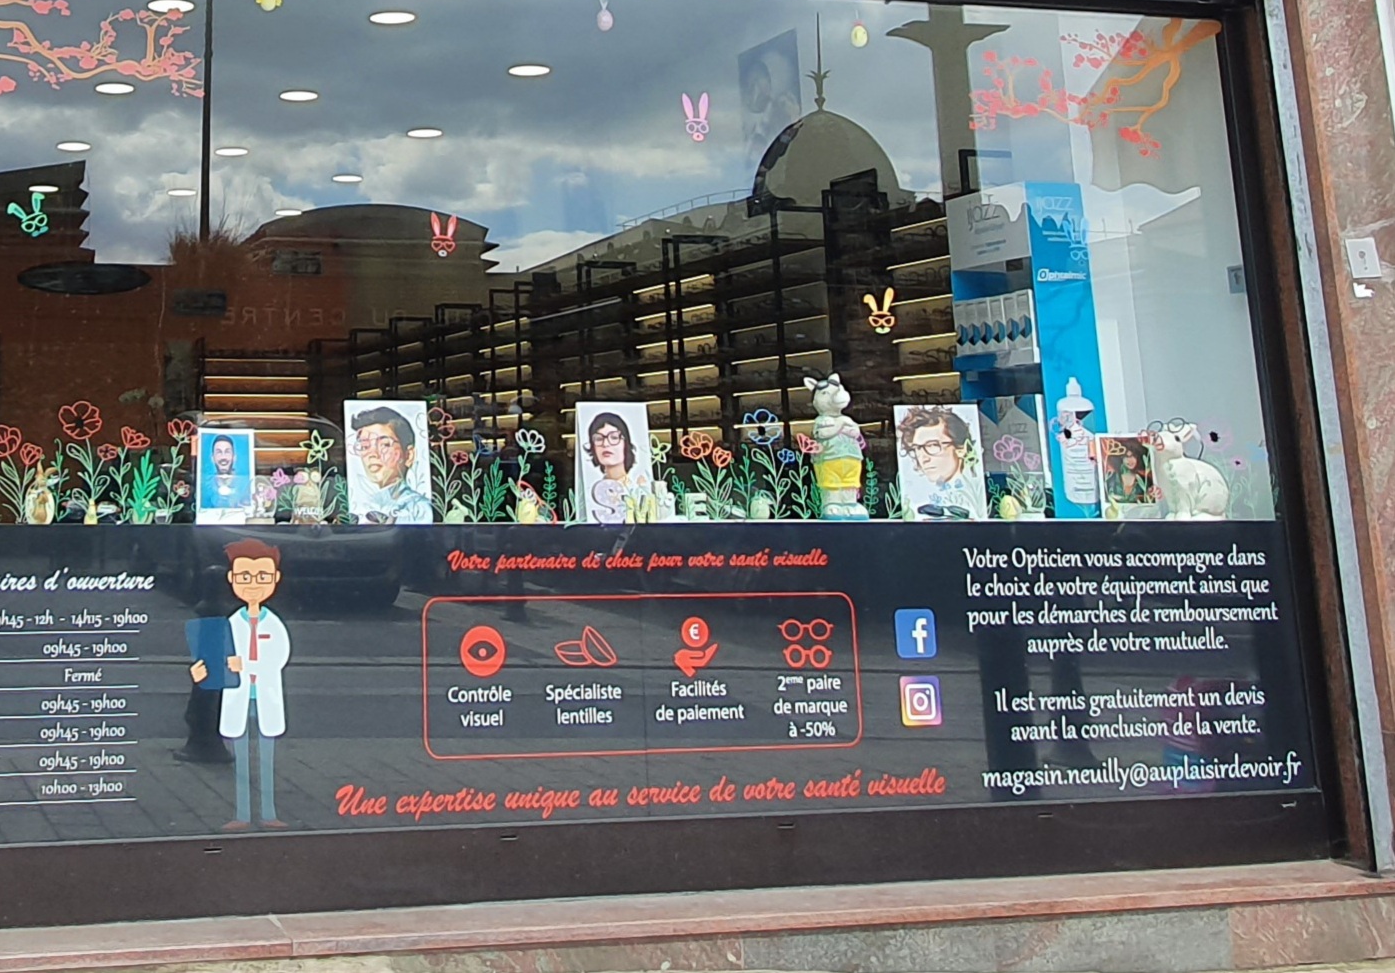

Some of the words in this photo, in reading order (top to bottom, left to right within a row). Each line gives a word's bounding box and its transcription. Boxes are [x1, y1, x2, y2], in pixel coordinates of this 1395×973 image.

[447, 550, 491, 571] Votre
[494, 553, 576, 574] partenaire
[582, 550, 601, 569] de
[606, 548, 643, 570] choix
[647, 552, 683, 572] pour
[688, 552, 724, 567] votre
[729, 548, 771, 567] santé
[773, 547, 828, 566] visuelle
[963, 547, 1008, 569] Votre
[1011, 547, 1082, 574] Opticien
[1084, 552, 1122, 567] vous
[1126, 549, 1224, 573] accompagne
[1227, 543, 1266, 566] dans
[44, 567, 155, 592] d'ouverture
[966, 574, 981, 597] le
[985, 573, 1030, 596] choix
[1034, 573, 1055, 595] de
[1057, 577, 1097, 595] votre
[1101, 575, 1196, 601] équipement
[1199, 575, 1237, 594] ainsi
[1241, 578, 1270, 600] que
[35, 609, 54, 625] 12h
[71, 609, 102, 628] 14h15
[113, 608, 148, 628] 19h00
[967, 610, 1009, 633] pour
[1012, 601, 1035, 625] les
[1038, 600, 1126, 625] démarches
[1130, 601, 1150, 623] de
[1153, 599, 1279, 622] remboursement
[43, 639, 81, 657] 09h45
[92, 638, 127, 657] 19h00
[1027, 633, 1084, 660] auprès
[1087, 629, 1108, 652] de
[1110, 632, 1151, 651] votre
[1154, 626, 1230, 650] mutuelle.
[64, 668, 102, 683] Fermé
[807, 674, 841, 694] paire
[447, 684, 513, 703] Contrôle
[545, 683, 622, 704] Spécialiste
[671, 680, 727, 697] Facilités
[995, 688, 1008, 712] Il
[1011, 690, 1036, 711] est
[1039, 692, 1086, 710] remis
[1090, 688, 1195, 716] gratuitement
[1198, 691, 1221, 707] un
[1224, 682, 1265, 706] devis
[41, 694, 80, 713] 09h45
[90, 693, 127, 713] 19h00
[773, 698, 792, 715] de
[795, 699, 848, 716] marque
[461, 709, 504, 727] visuel
[557, 707, 613, 725] lentilles
[656, 704, 674, 722] de
[677, 703, 745, 725] paiement
[40, 722, 79, 741] 09h45
[90, 721, 125, 740] 19h00
[789, 722, 798, 738] à
[800, 721, 836, 737] -50%
[1010, 721, 1058, 741] avant
[1061, 716, 1078, 740] la
[1081, 714, 1169, 738] conclusion
[1172, 712, 1193, 736] de
[1196, 712, 1211, 736] la
[1213, 714, 1262, 735] vente.
[39, 750, 78, 770] 09h45
[89, 749, 125, 769] 19h00
[982, 751, 1302, 794] magasin.neuilly@auplaisirdevoir.fr
[41, 778, 77, 796] 10h00
[88, 777, 123, 798] 13h00
[335, 784, 388, 815] Une
[395, 788, 496, 821] expertise
[505, 786, 581, 819] unique
[588, 787, 619, 806] au
[627, 781, 701, 805] service
[709, 776, 736, 802] de
[743, 778, 796, 801] votre
[803, 769, 862, 798] santé
[867, 767, 946, 796] visuelle
